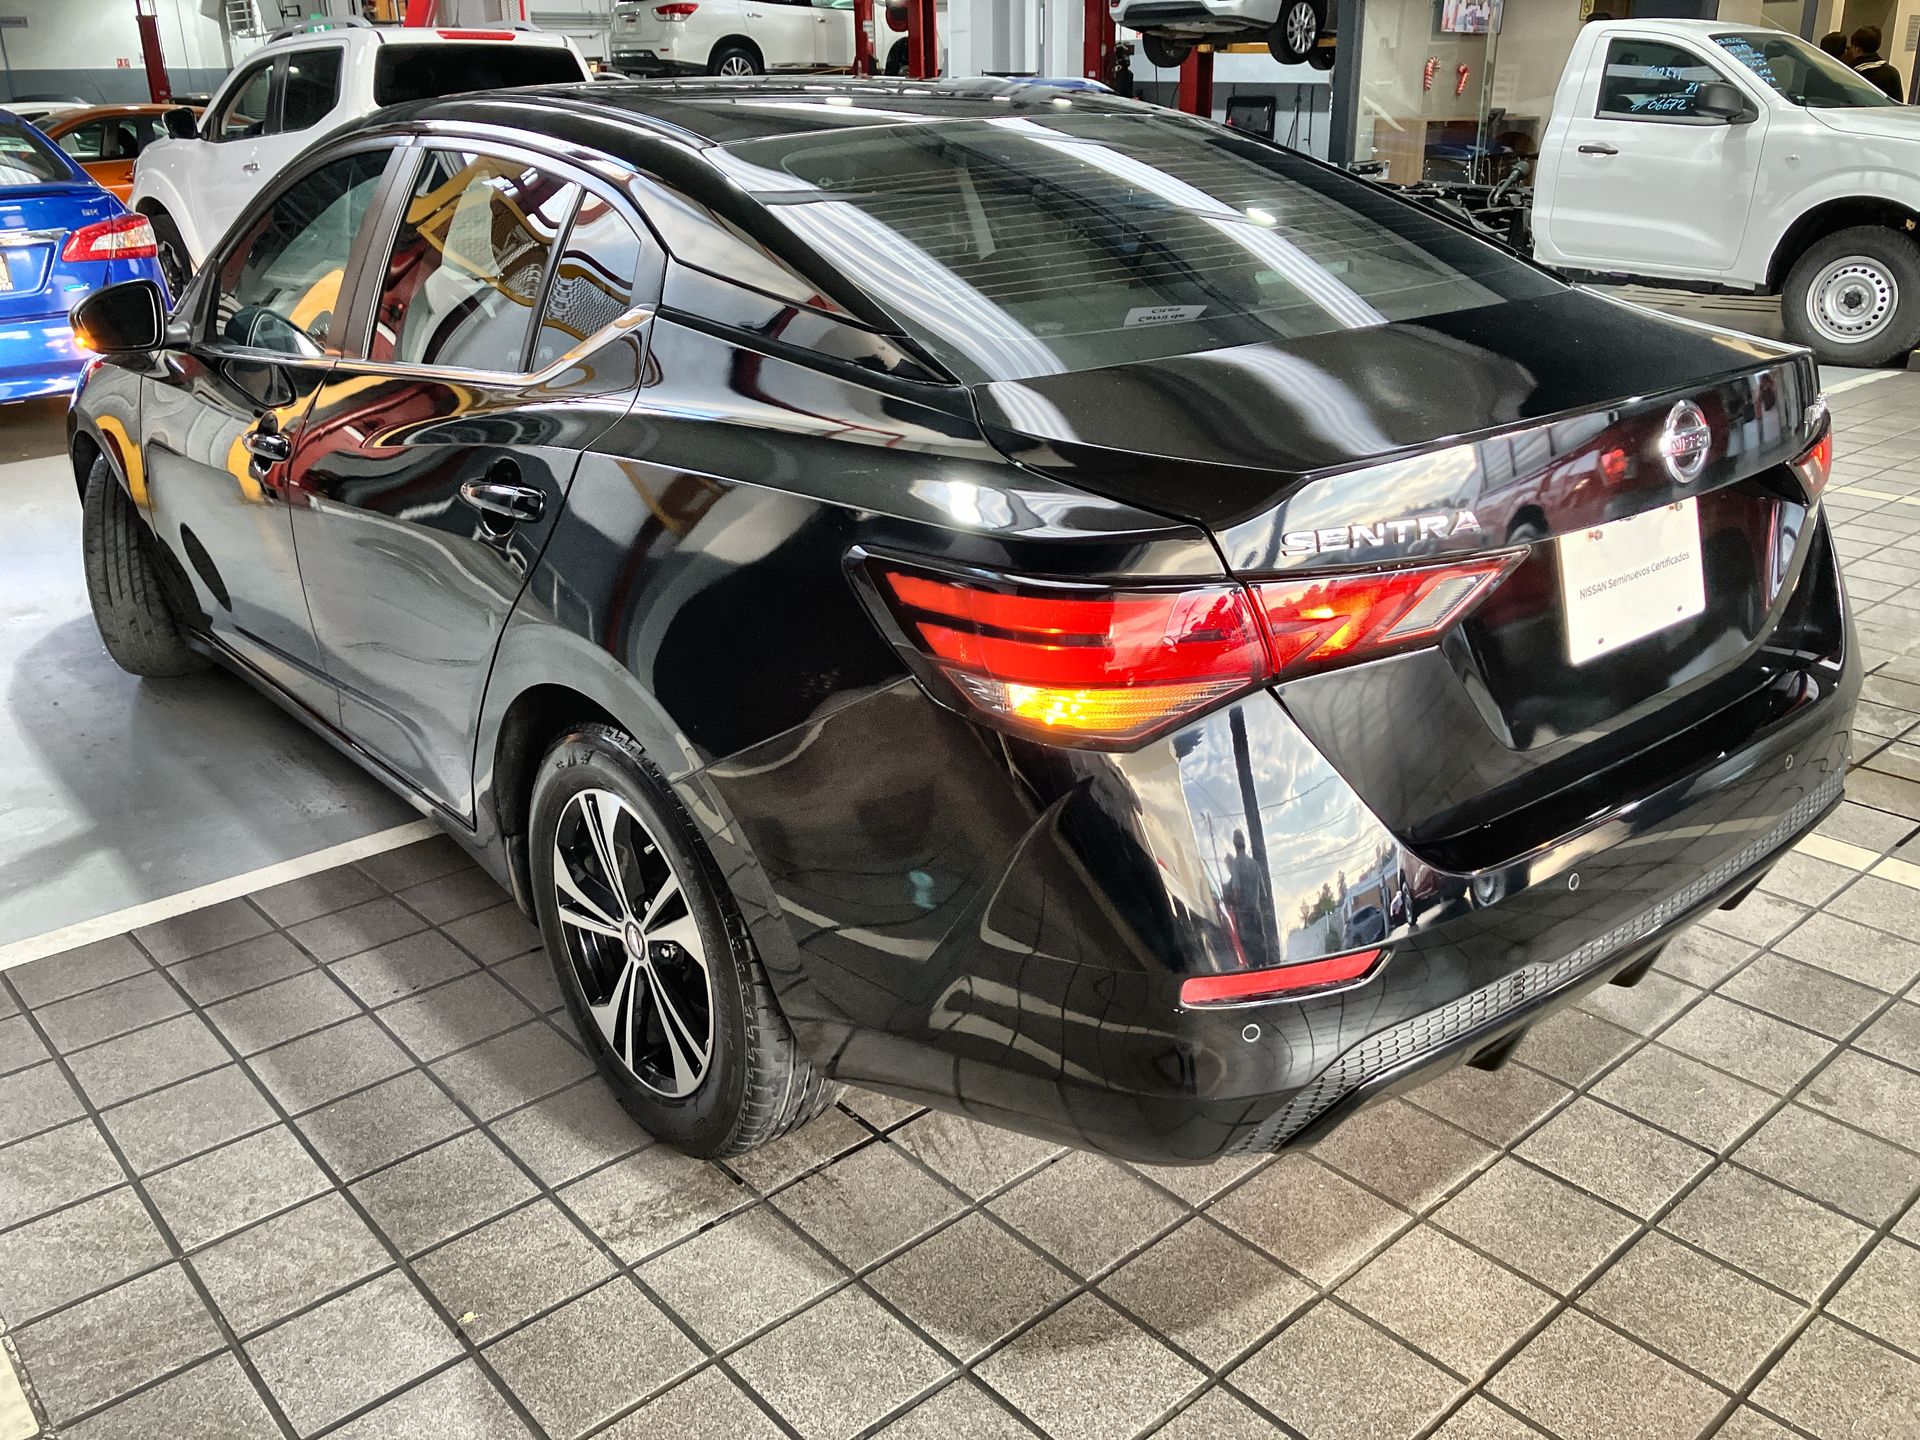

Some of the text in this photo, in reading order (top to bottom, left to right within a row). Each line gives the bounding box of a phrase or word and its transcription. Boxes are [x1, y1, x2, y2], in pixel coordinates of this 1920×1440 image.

[1279, 511, 1483, 556] SENTRA
[1579, 551, 1690, 600] NISSAN Seminuevos Certificados
